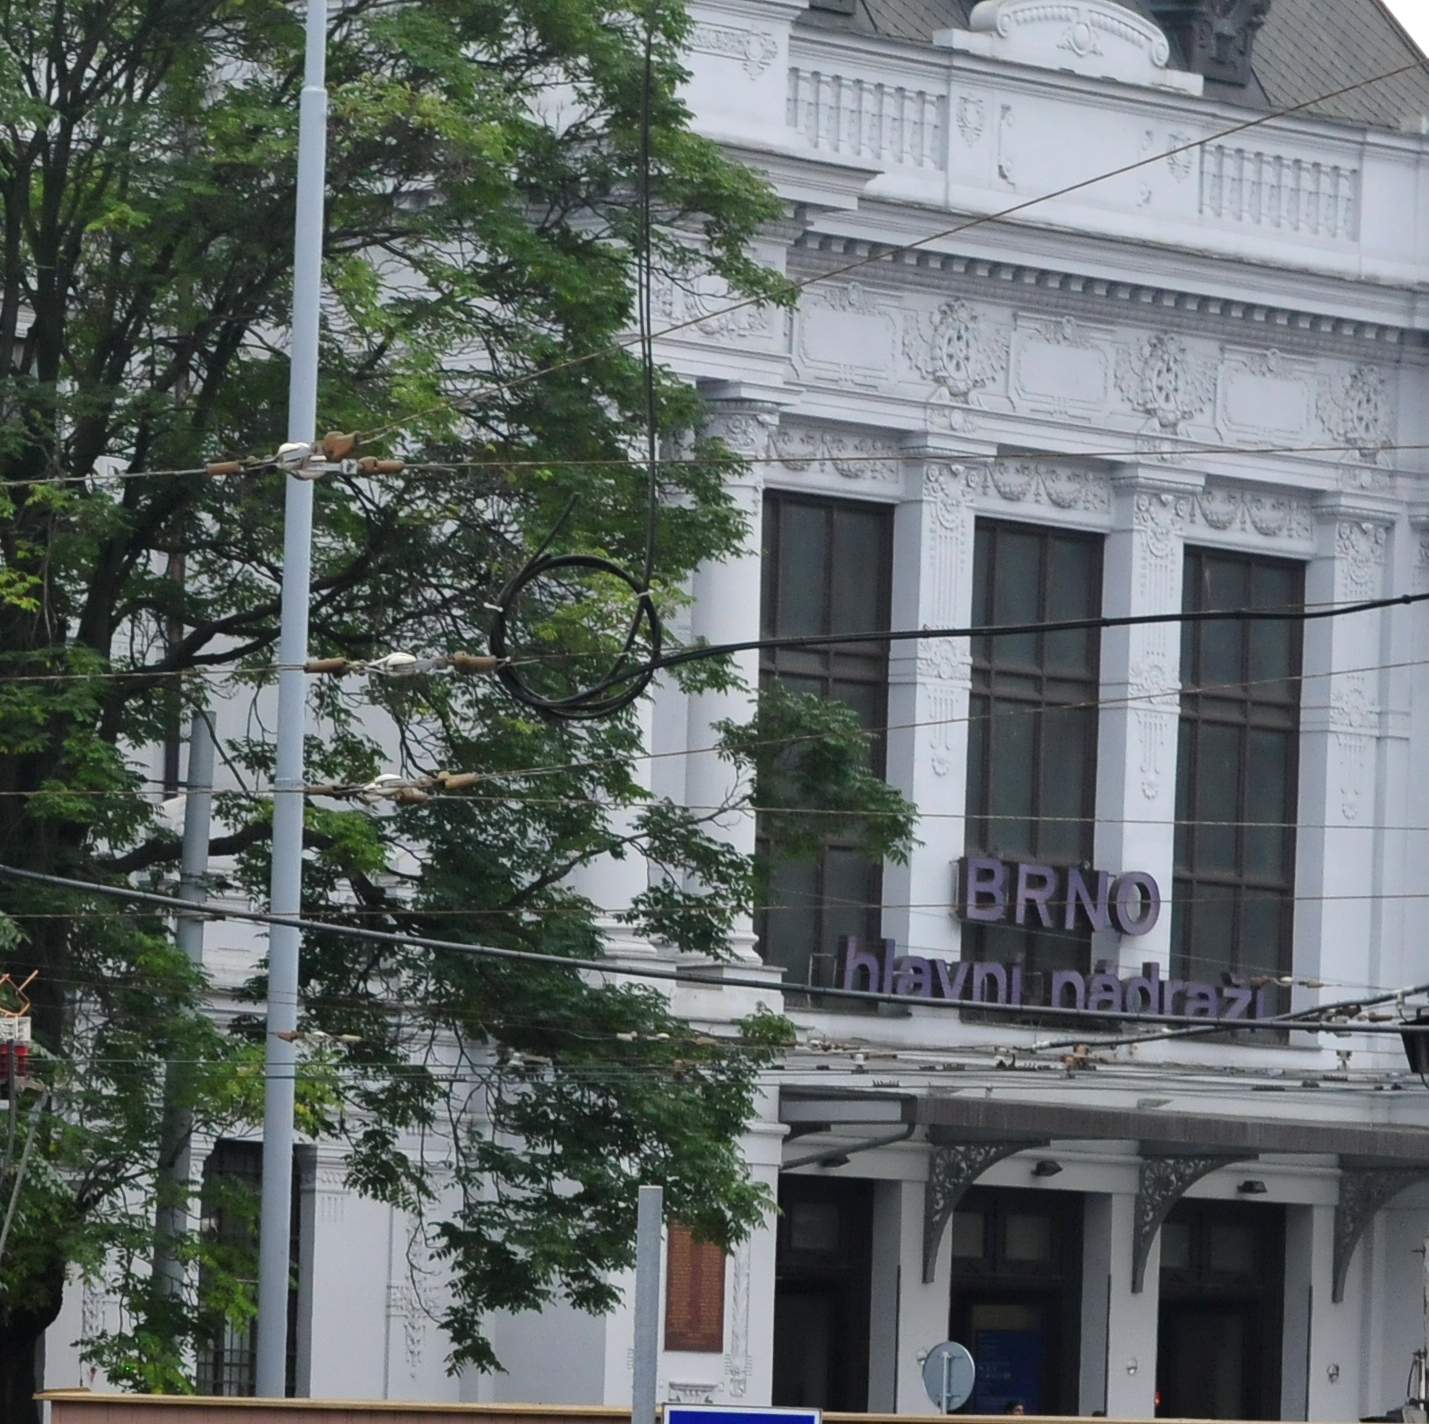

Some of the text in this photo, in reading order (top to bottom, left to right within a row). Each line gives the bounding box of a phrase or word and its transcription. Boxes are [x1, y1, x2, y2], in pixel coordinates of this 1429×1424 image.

[965, 857, 1161, 936] BRNO
[844, 935, 1267, 1023] hlavní nádraží
